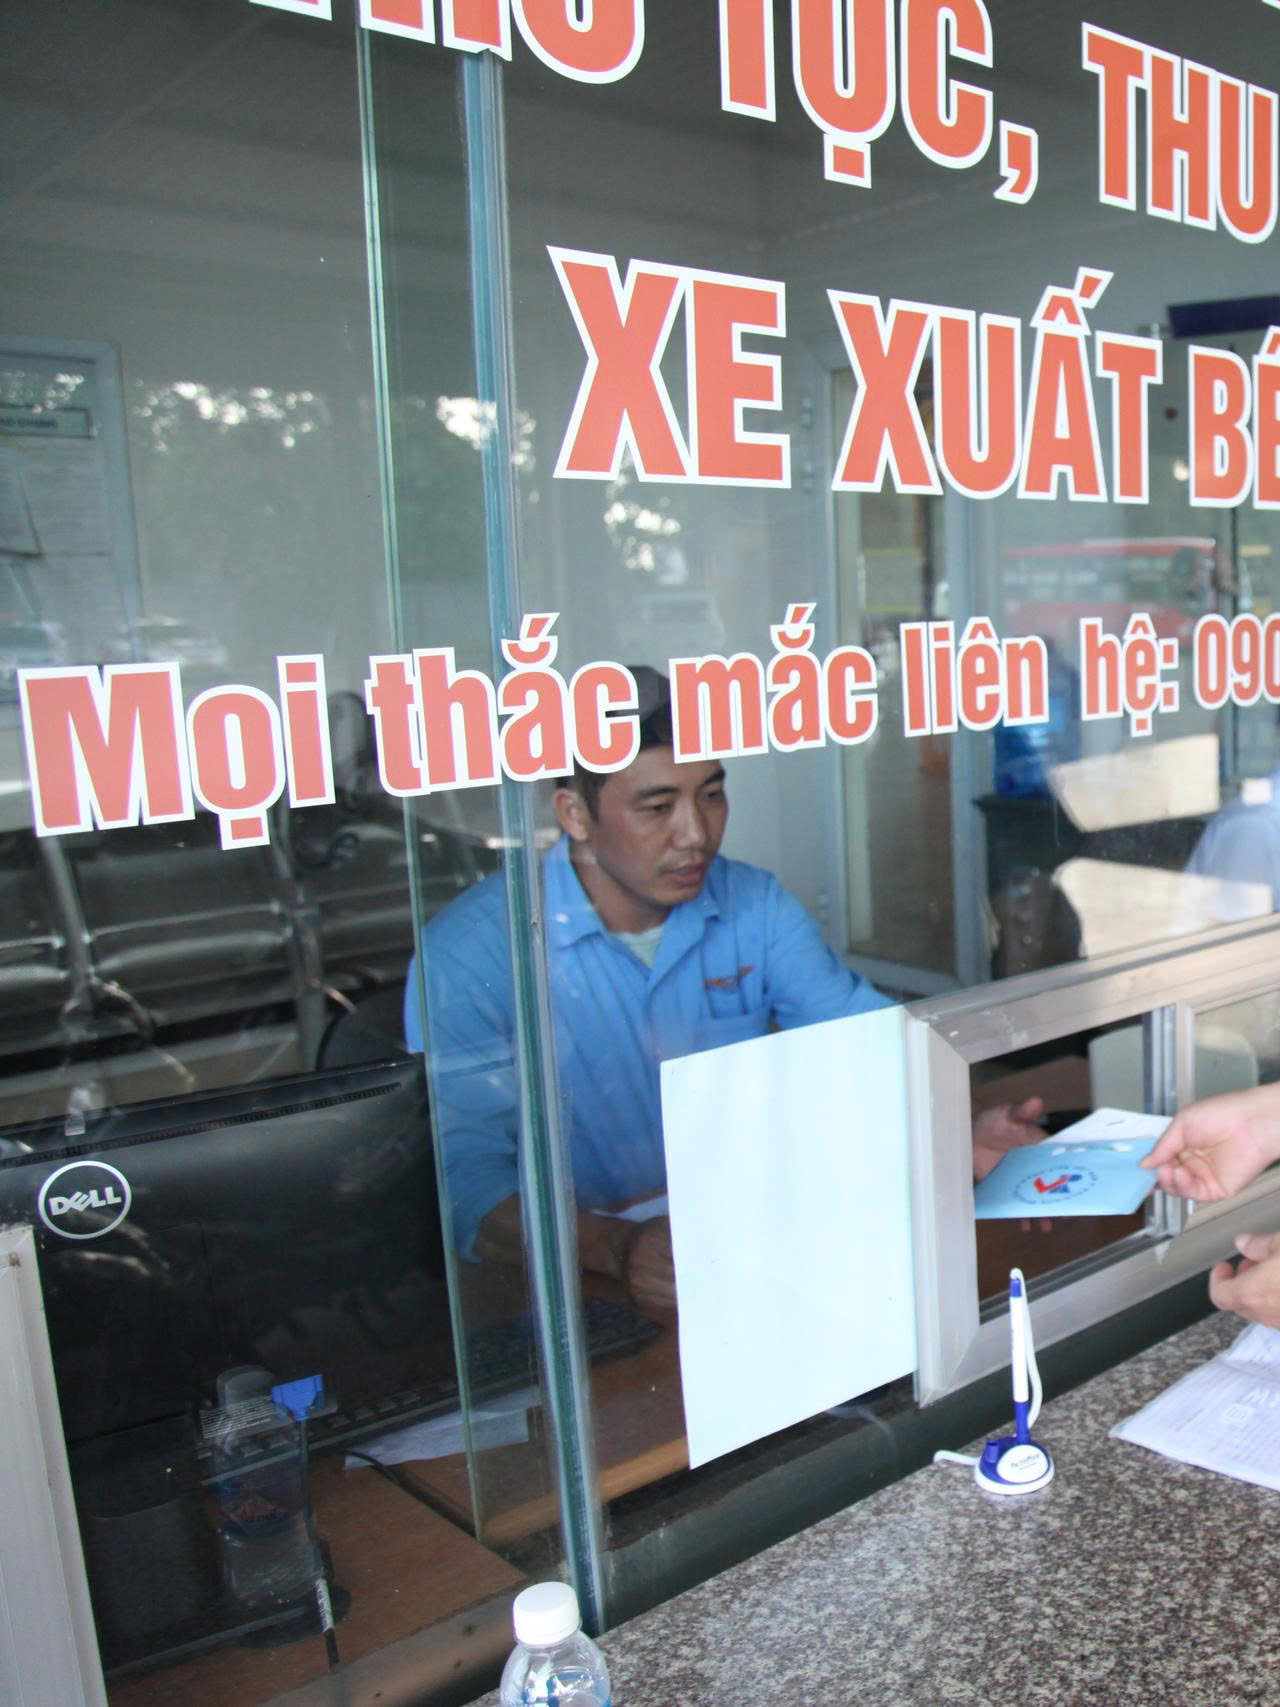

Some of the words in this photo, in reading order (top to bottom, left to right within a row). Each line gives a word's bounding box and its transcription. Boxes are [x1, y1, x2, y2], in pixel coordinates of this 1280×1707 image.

[1082, 22, 1278, 244] THU
[546, 245, 791, 488] XE
[826, 266, 1163, 504] XUẤT
[17, 654, 336, 850] Mọi
[364, 612, 641, 798] thắc
[668, 602, 879, 764] mắc
[900, 616, 1049, 738] liên
[1079, 613, 1180, 737] hệ:
[48, 1186, 122, 1216] DELL
